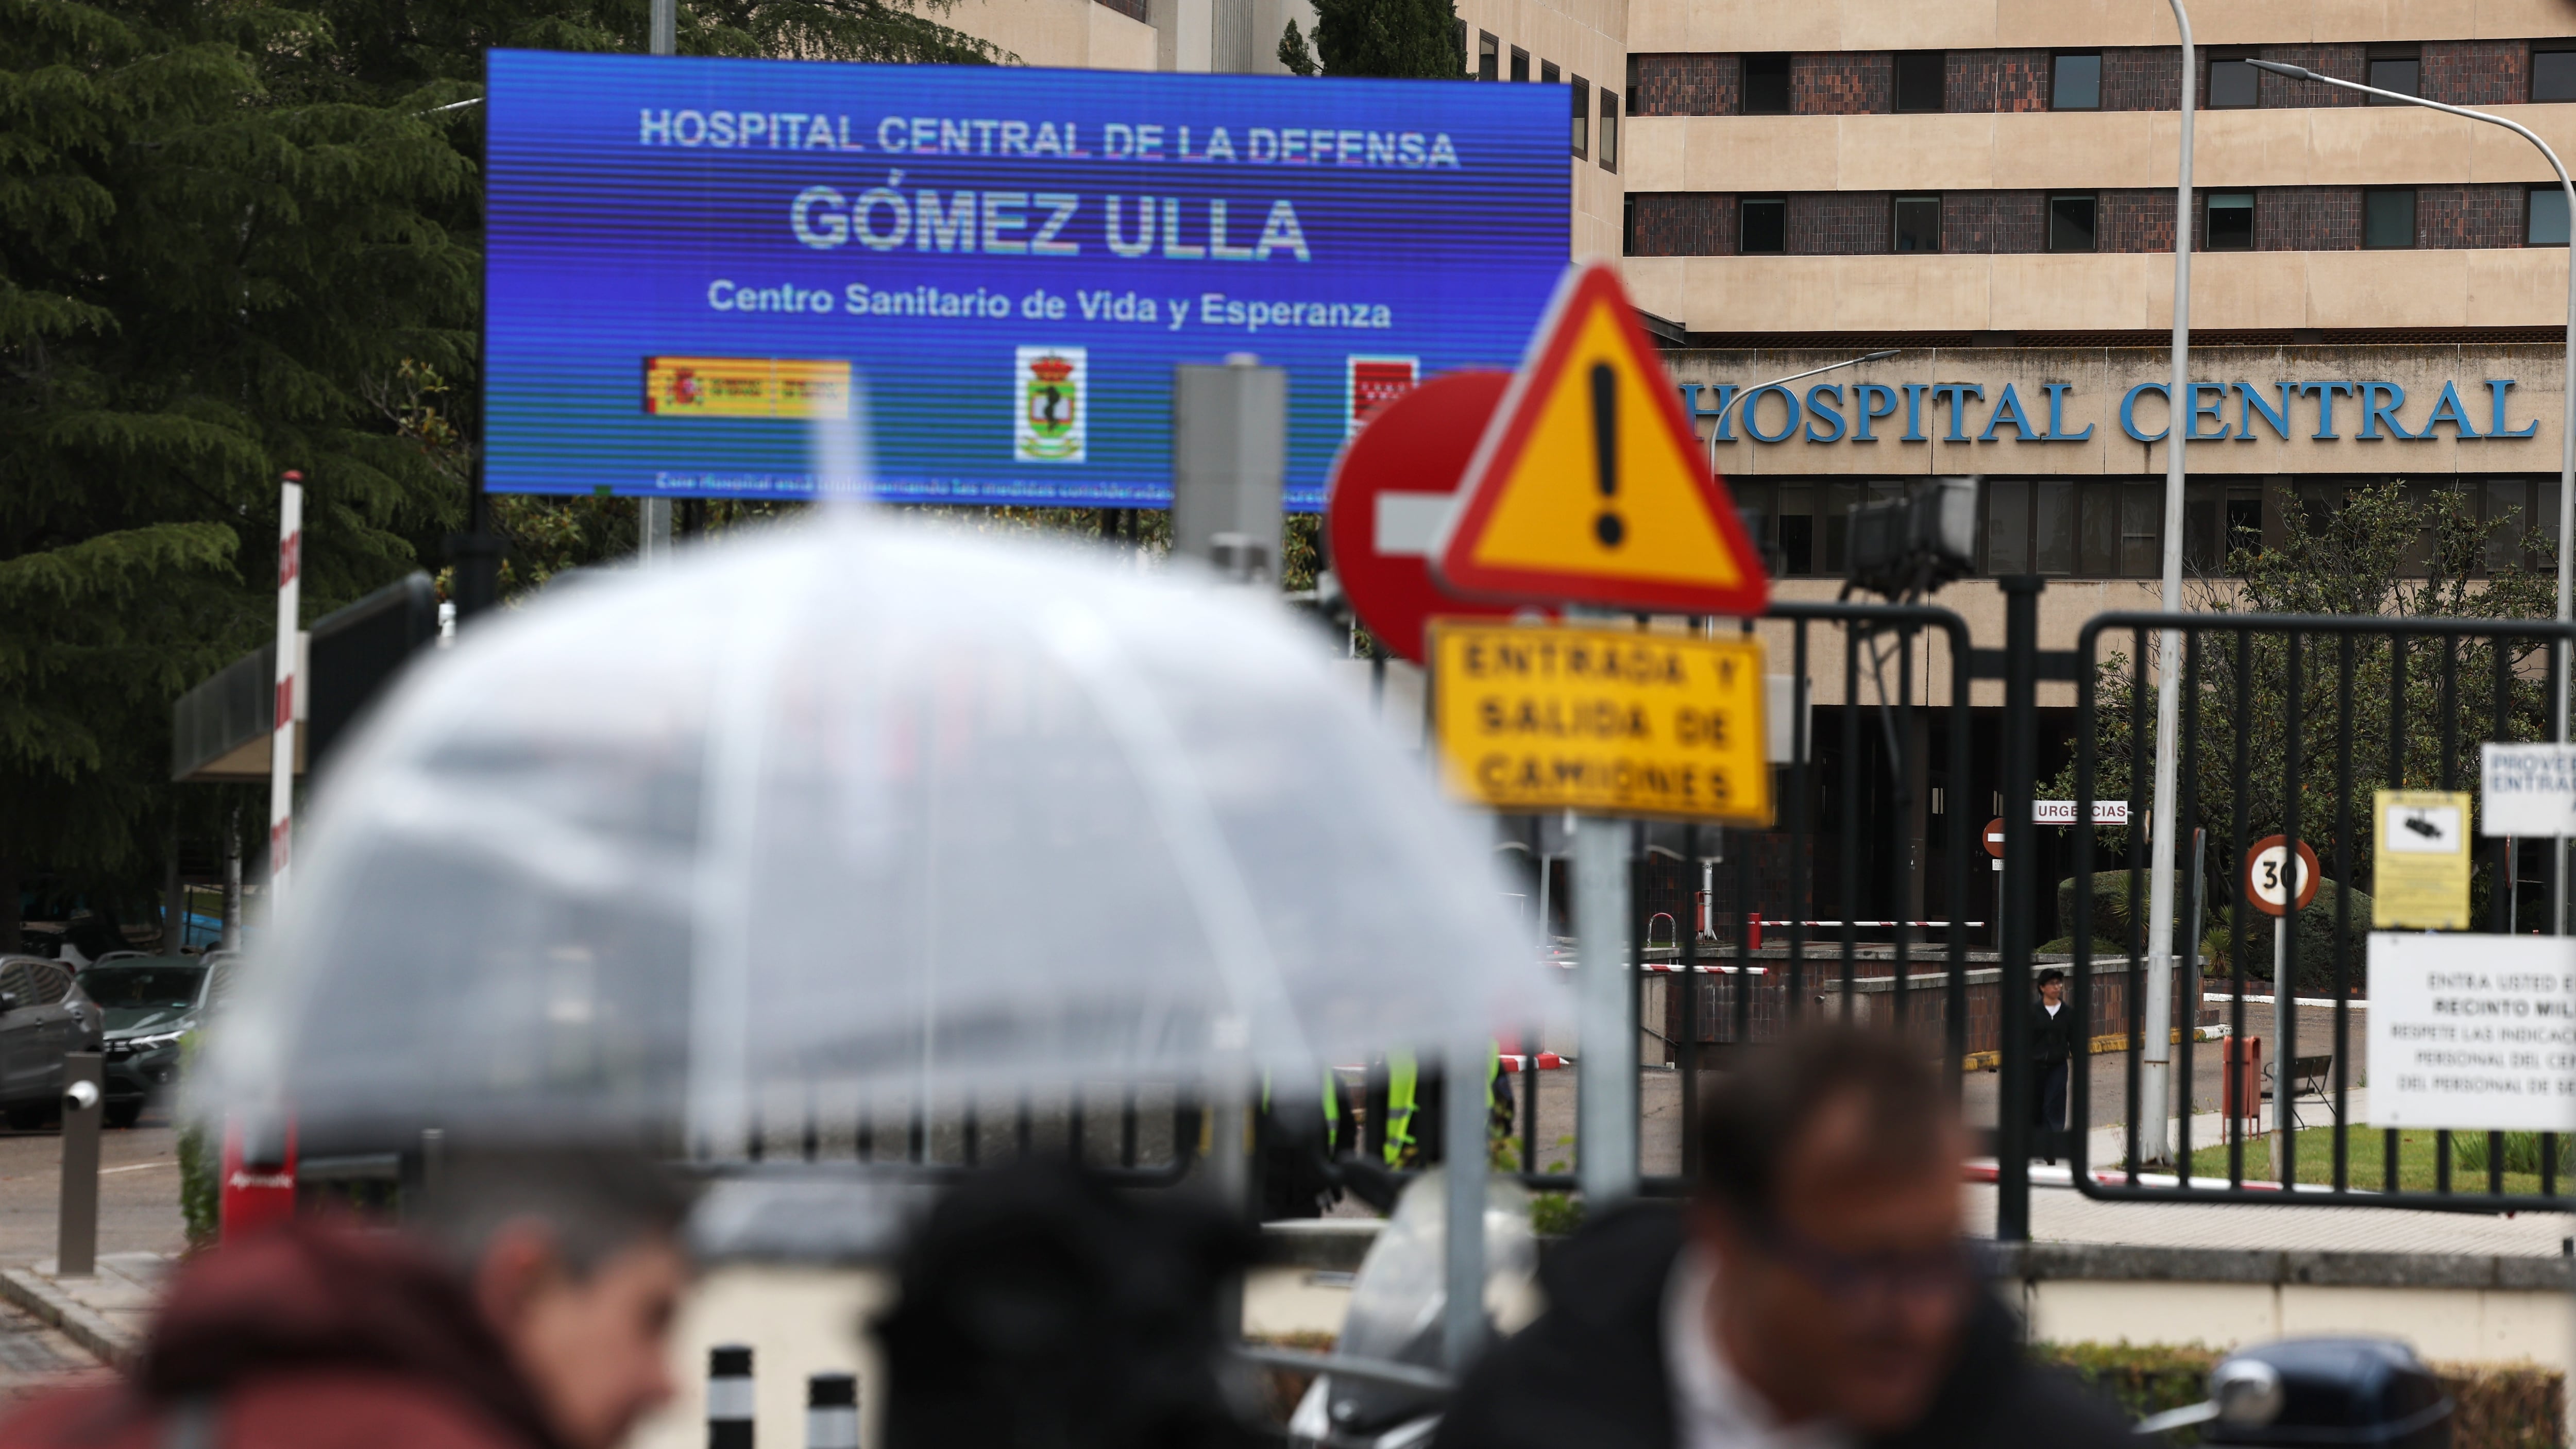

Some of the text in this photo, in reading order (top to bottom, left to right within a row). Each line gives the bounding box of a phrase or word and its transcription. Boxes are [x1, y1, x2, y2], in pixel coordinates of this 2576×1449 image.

[639, 107, 1462, 169] HOSPITAL CENTRAL DE LA DEFENSA
[790, 168, 1311, 262] GÓMEZ ULLA
[708, 278, 1392, 333] Centro Sanitario de Vida y Esperanza
[1680, 380, 2539, 442] HOSPITAL CENTRAL
[1463, 634, 1740, 693] ENTRADA Y
[1478, 696, 1732, 751] SALIDA DE
[1477, 755, 1734, 802] CAMIONES
[2039, 805, 2126, 817] URGECIAS
[2262, 861, 2298, 890] 30
[2427, 971, 2492, 992] ENTRA
[2496, 973, 2557, 993] USTED
[2432, 998, 2576, 1019] RECINTO MIL
[2390, 1022, 2458, 1042] RESPETE
[2461, 1024, 2495, 1043] LAS
[2415, 1049, 2505, 1069] PERSONAL
[2509, 1050, 2540, 1069] DEL
[2397, 1073, 2427, 1093] DEL
[2431, 1075, 2522, 1095] PERSONAL
[2526, 1077, 2550, 1096] DE
